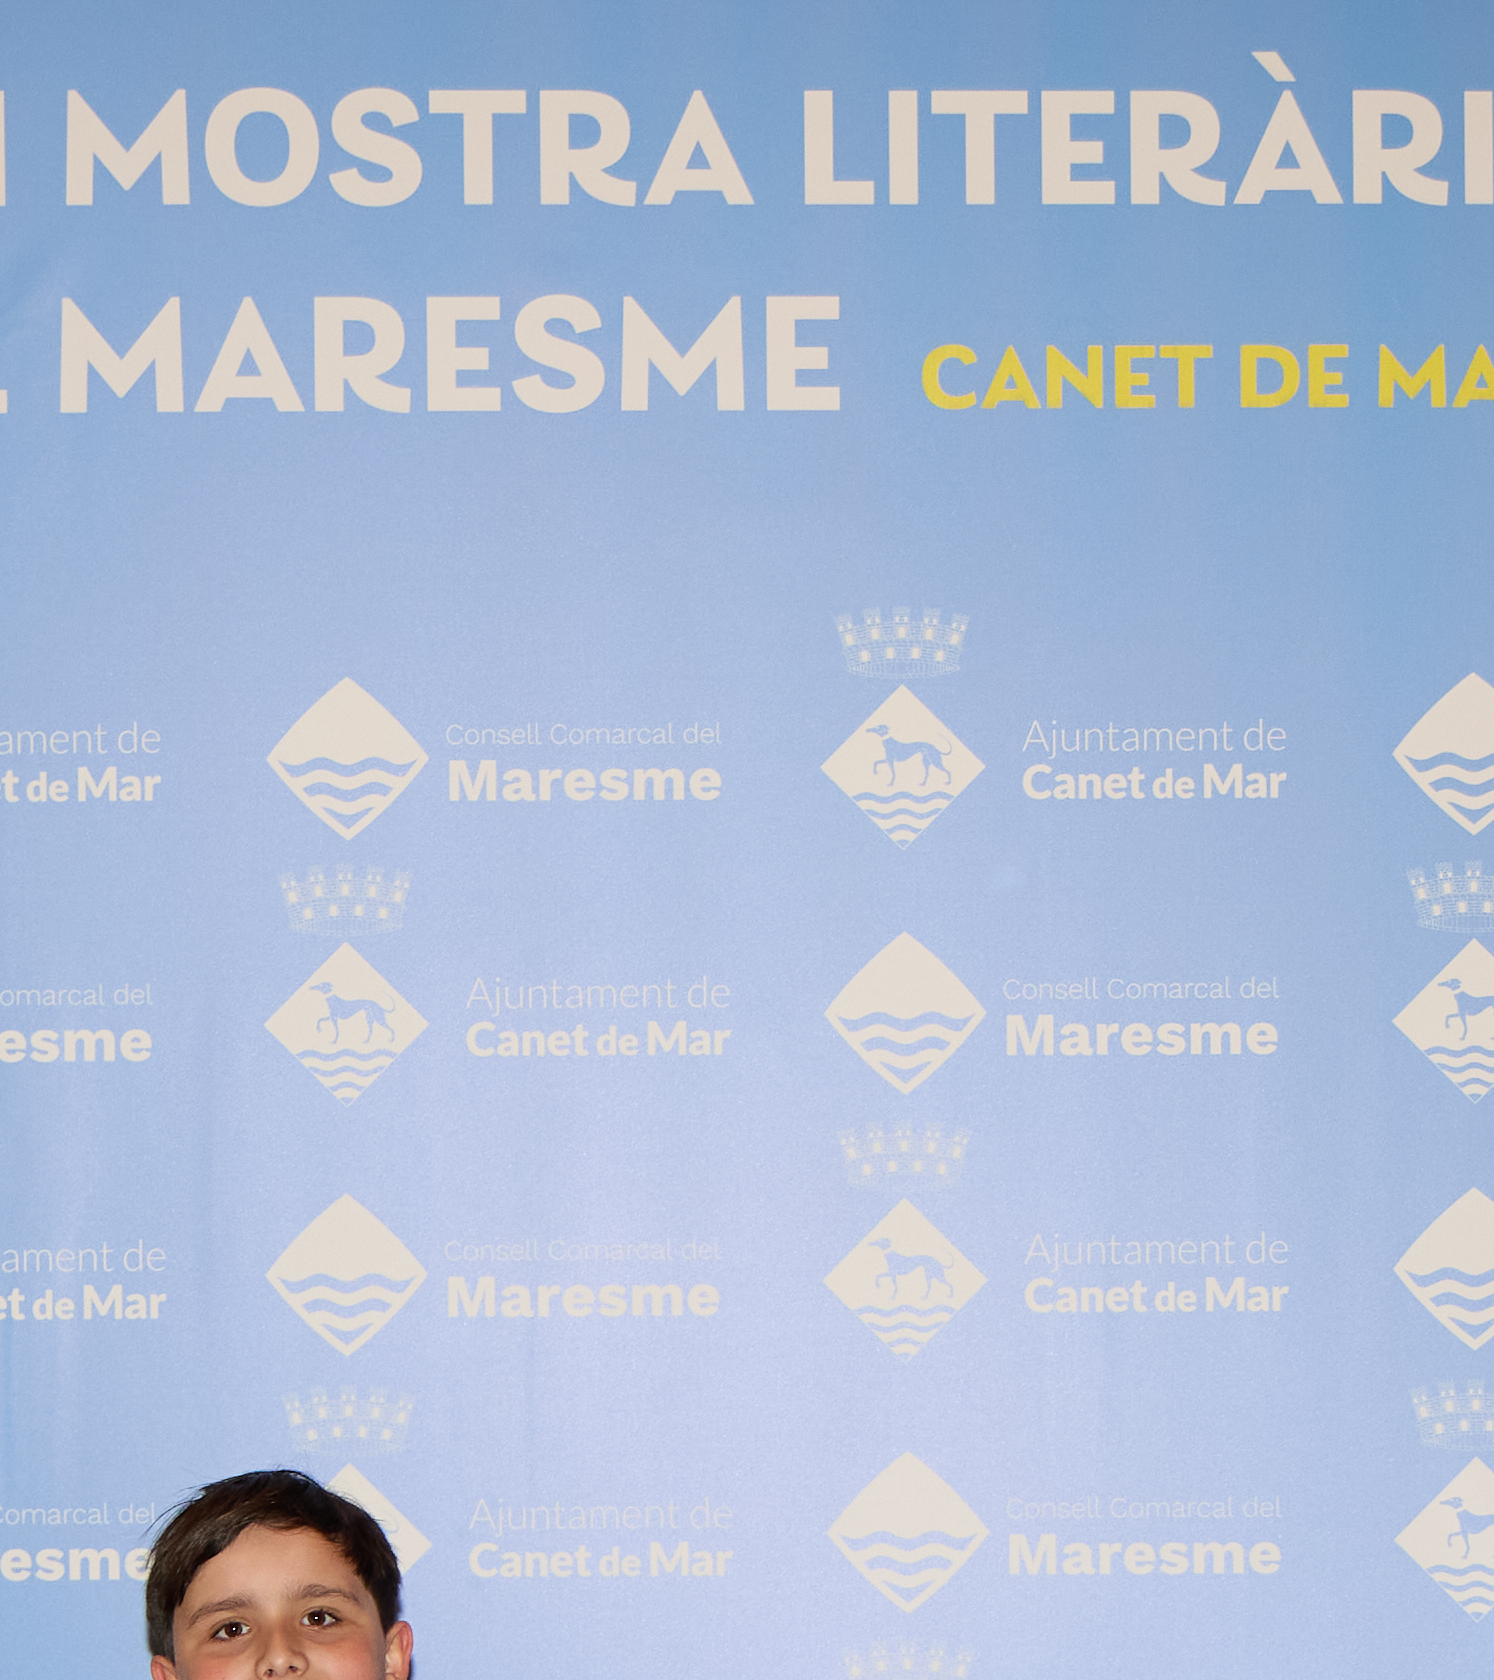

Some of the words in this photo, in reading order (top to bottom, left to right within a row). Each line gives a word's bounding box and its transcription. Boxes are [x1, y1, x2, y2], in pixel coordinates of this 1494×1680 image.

[64, 86, 755, 206] MOSTRA
[59, 294, 841, 414] MARESME
[921, 343, 1213, 410] CANET
[1239, 344, 1350, 409] DE
[117, 722, 161, 755] de
[445, 722, 540, 744] Consell
[550, 722, 675, 744] Comarcal
[684, 722, 722, 745] del
[27, 771, 69, 803] de
[77, 768, 159, 803] Mar
[449, 760, 720, 801] Maresme
[123, 1240, 167, 1273] de
[33, 1289, 75, 1321] de
[83, 1286, 165, 1321] Mar
[119, 1502, 157, 1525] del
